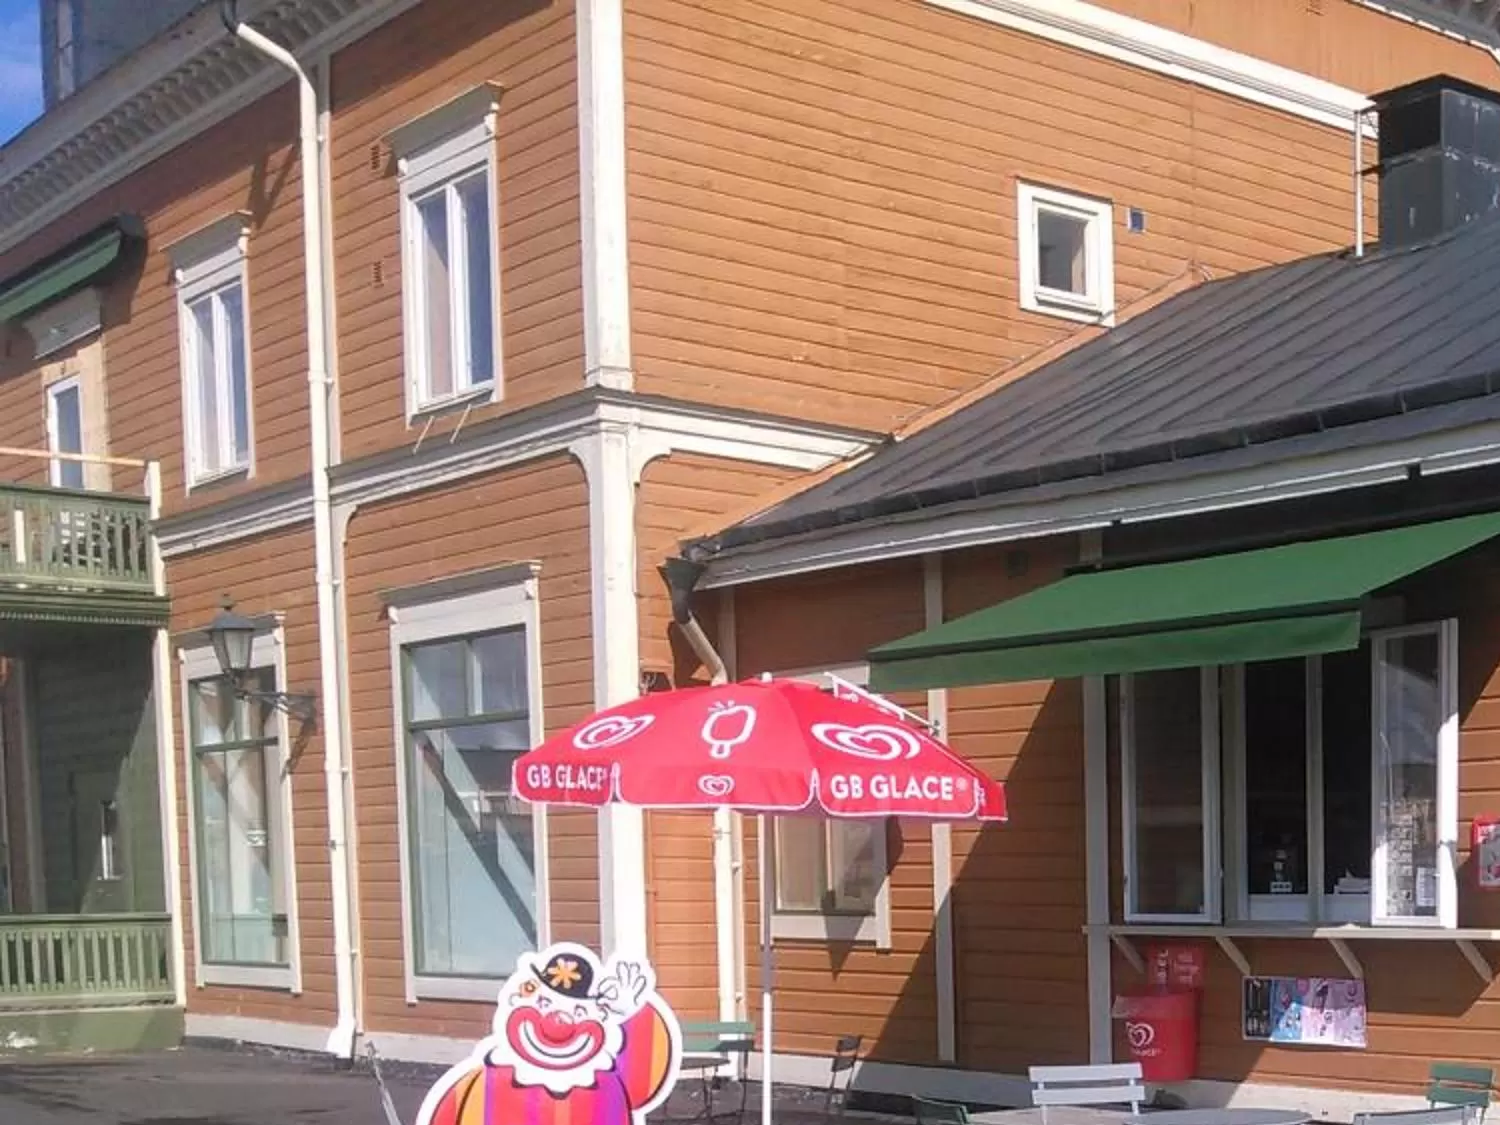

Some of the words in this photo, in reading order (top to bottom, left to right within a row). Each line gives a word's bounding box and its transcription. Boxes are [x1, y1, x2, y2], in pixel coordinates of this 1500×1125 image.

[527, 764, 551, 789] GB
[830, 774, 863, 799] GB
[869, 774, 953, 800] GLACE
